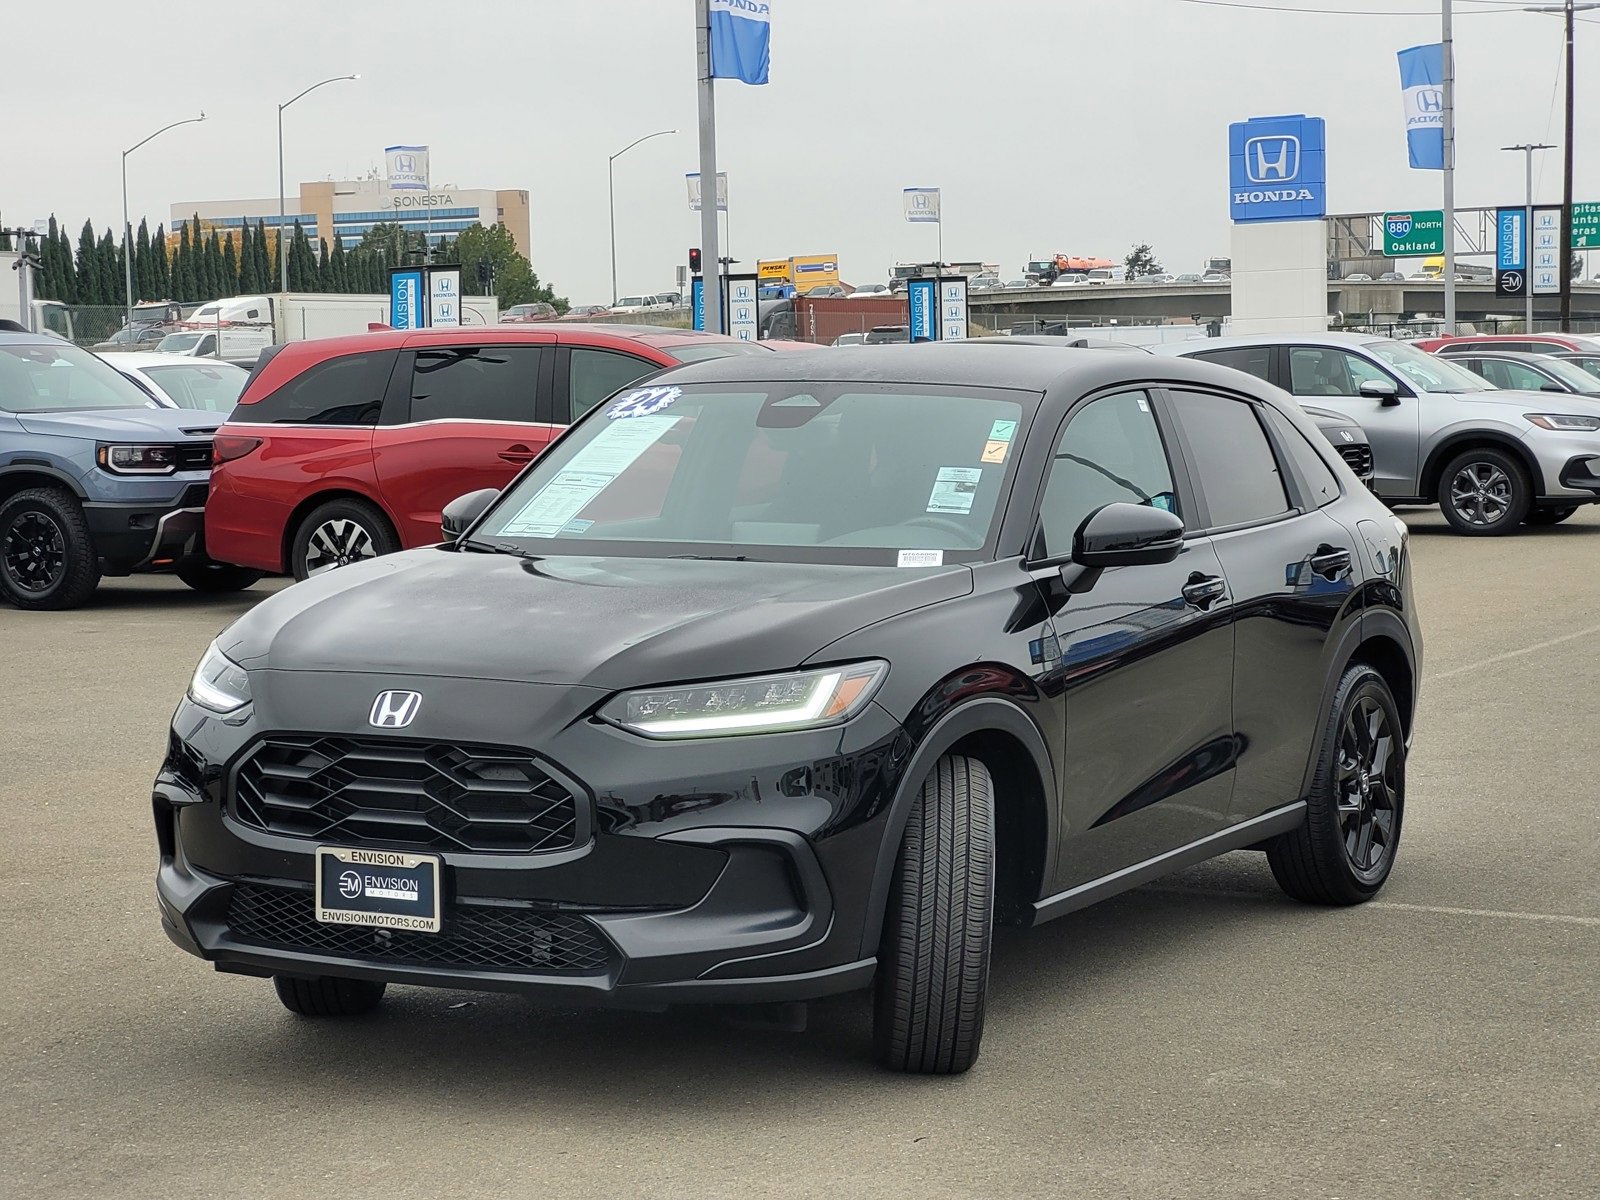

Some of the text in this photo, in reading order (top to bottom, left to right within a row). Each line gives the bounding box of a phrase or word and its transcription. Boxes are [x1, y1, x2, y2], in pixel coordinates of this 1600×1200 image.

[393, 194, 454, 207] SONESTA
[1234, 189, 1315, 204] HONDA
[1389, 221, 1442, 233] 880 NORTH
[1391, 241, 1436, 252] Oakland
[1503, 215, 1513, 265] ENVISION
[914, 287, 923, 337] ENVISION
[350, 851, 405, 866] ENVISION
[364, 875, 419, 892] ENVISION
[369, 889, 414, 899] MOTORS
[321, 911, 435, 931] ENVISIONMOTORS.COM
